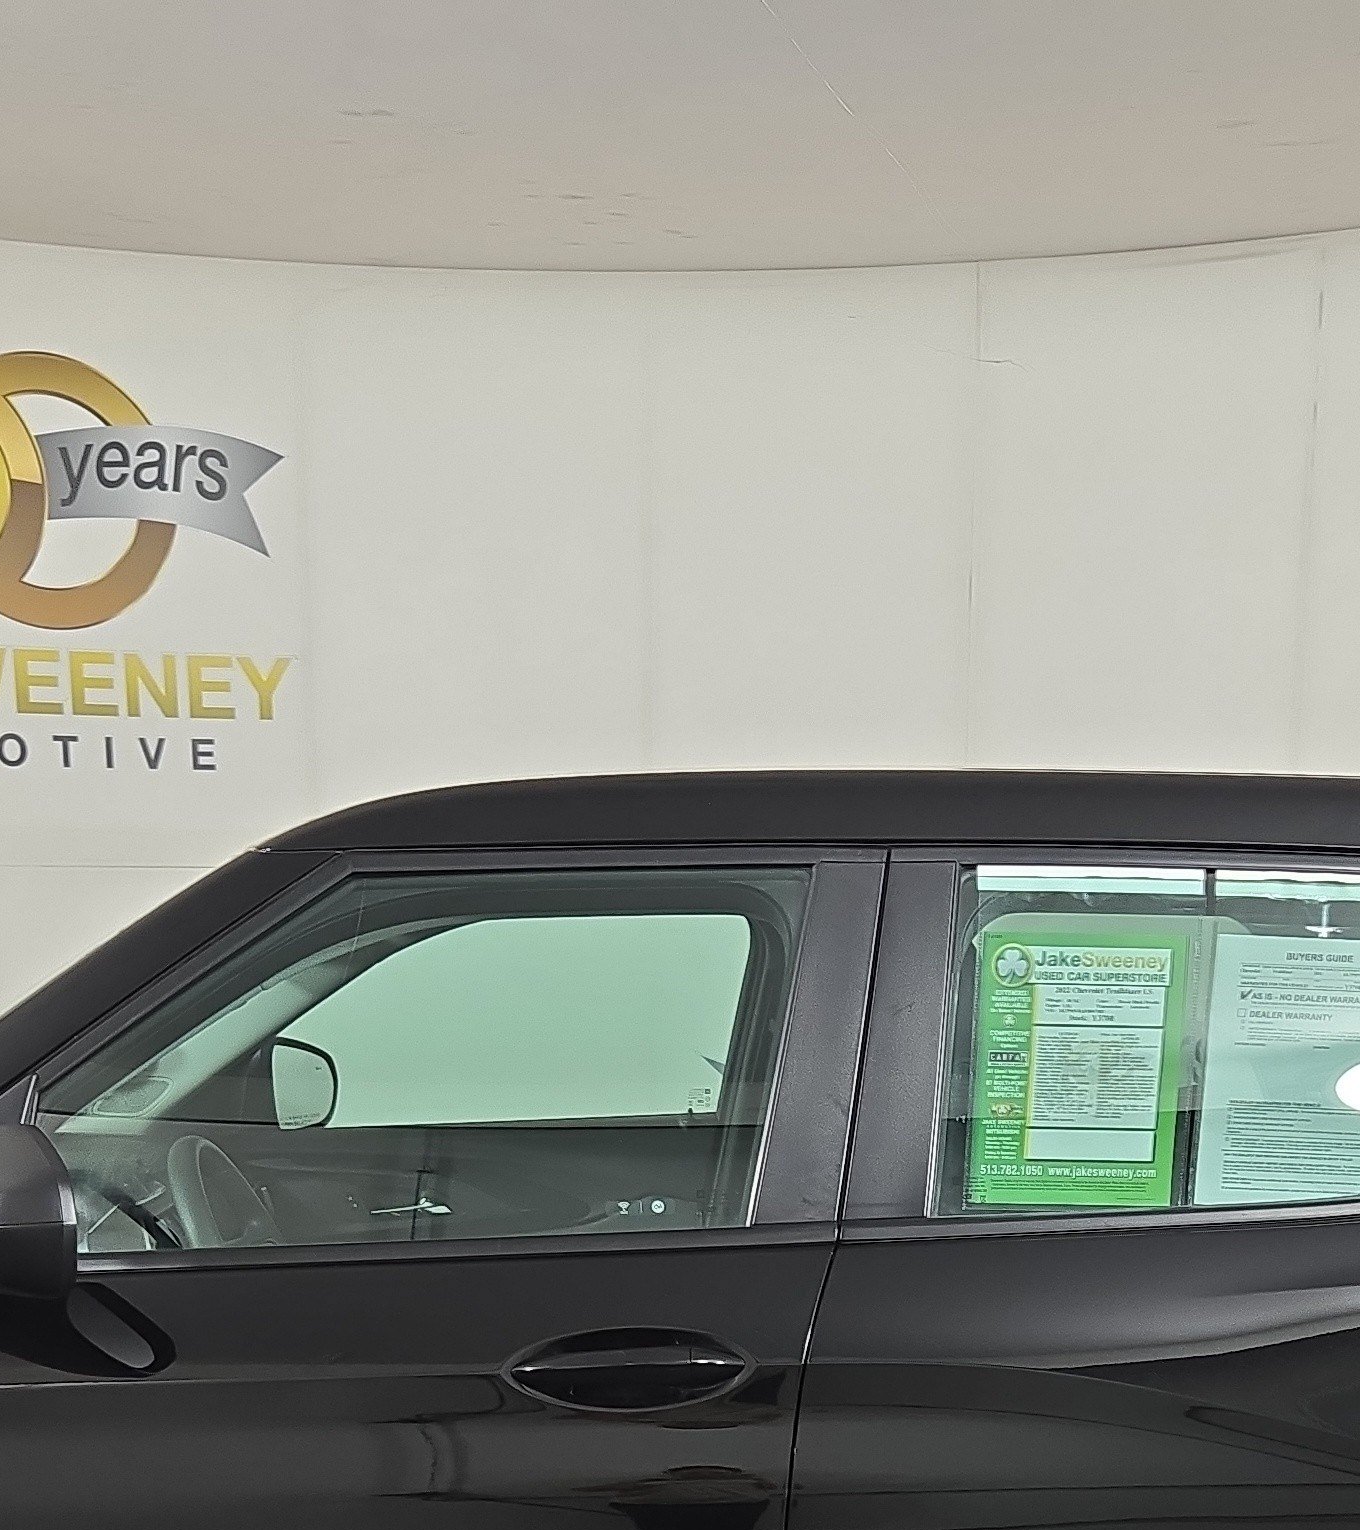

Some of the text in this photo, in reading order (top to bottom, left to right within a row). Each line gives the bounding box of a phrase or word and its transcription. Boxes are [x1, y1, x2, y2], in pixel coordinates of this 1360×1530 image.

[57, 440, 230, 507] years
[1285, 952, 1354, 963] BUYERS GUIDE
[1034, 971, 1167, 983] USED CAR SUPERSTORE
[1251, 992, 1263, 1000] AS
[1294, 994, 1328, 1003] DEALER
[1249, 1010, 1332, 1021] DEALER WARRANTY
[980, 1165, 1157, 1179] 513.782.1050 www.jakesweeney.com
